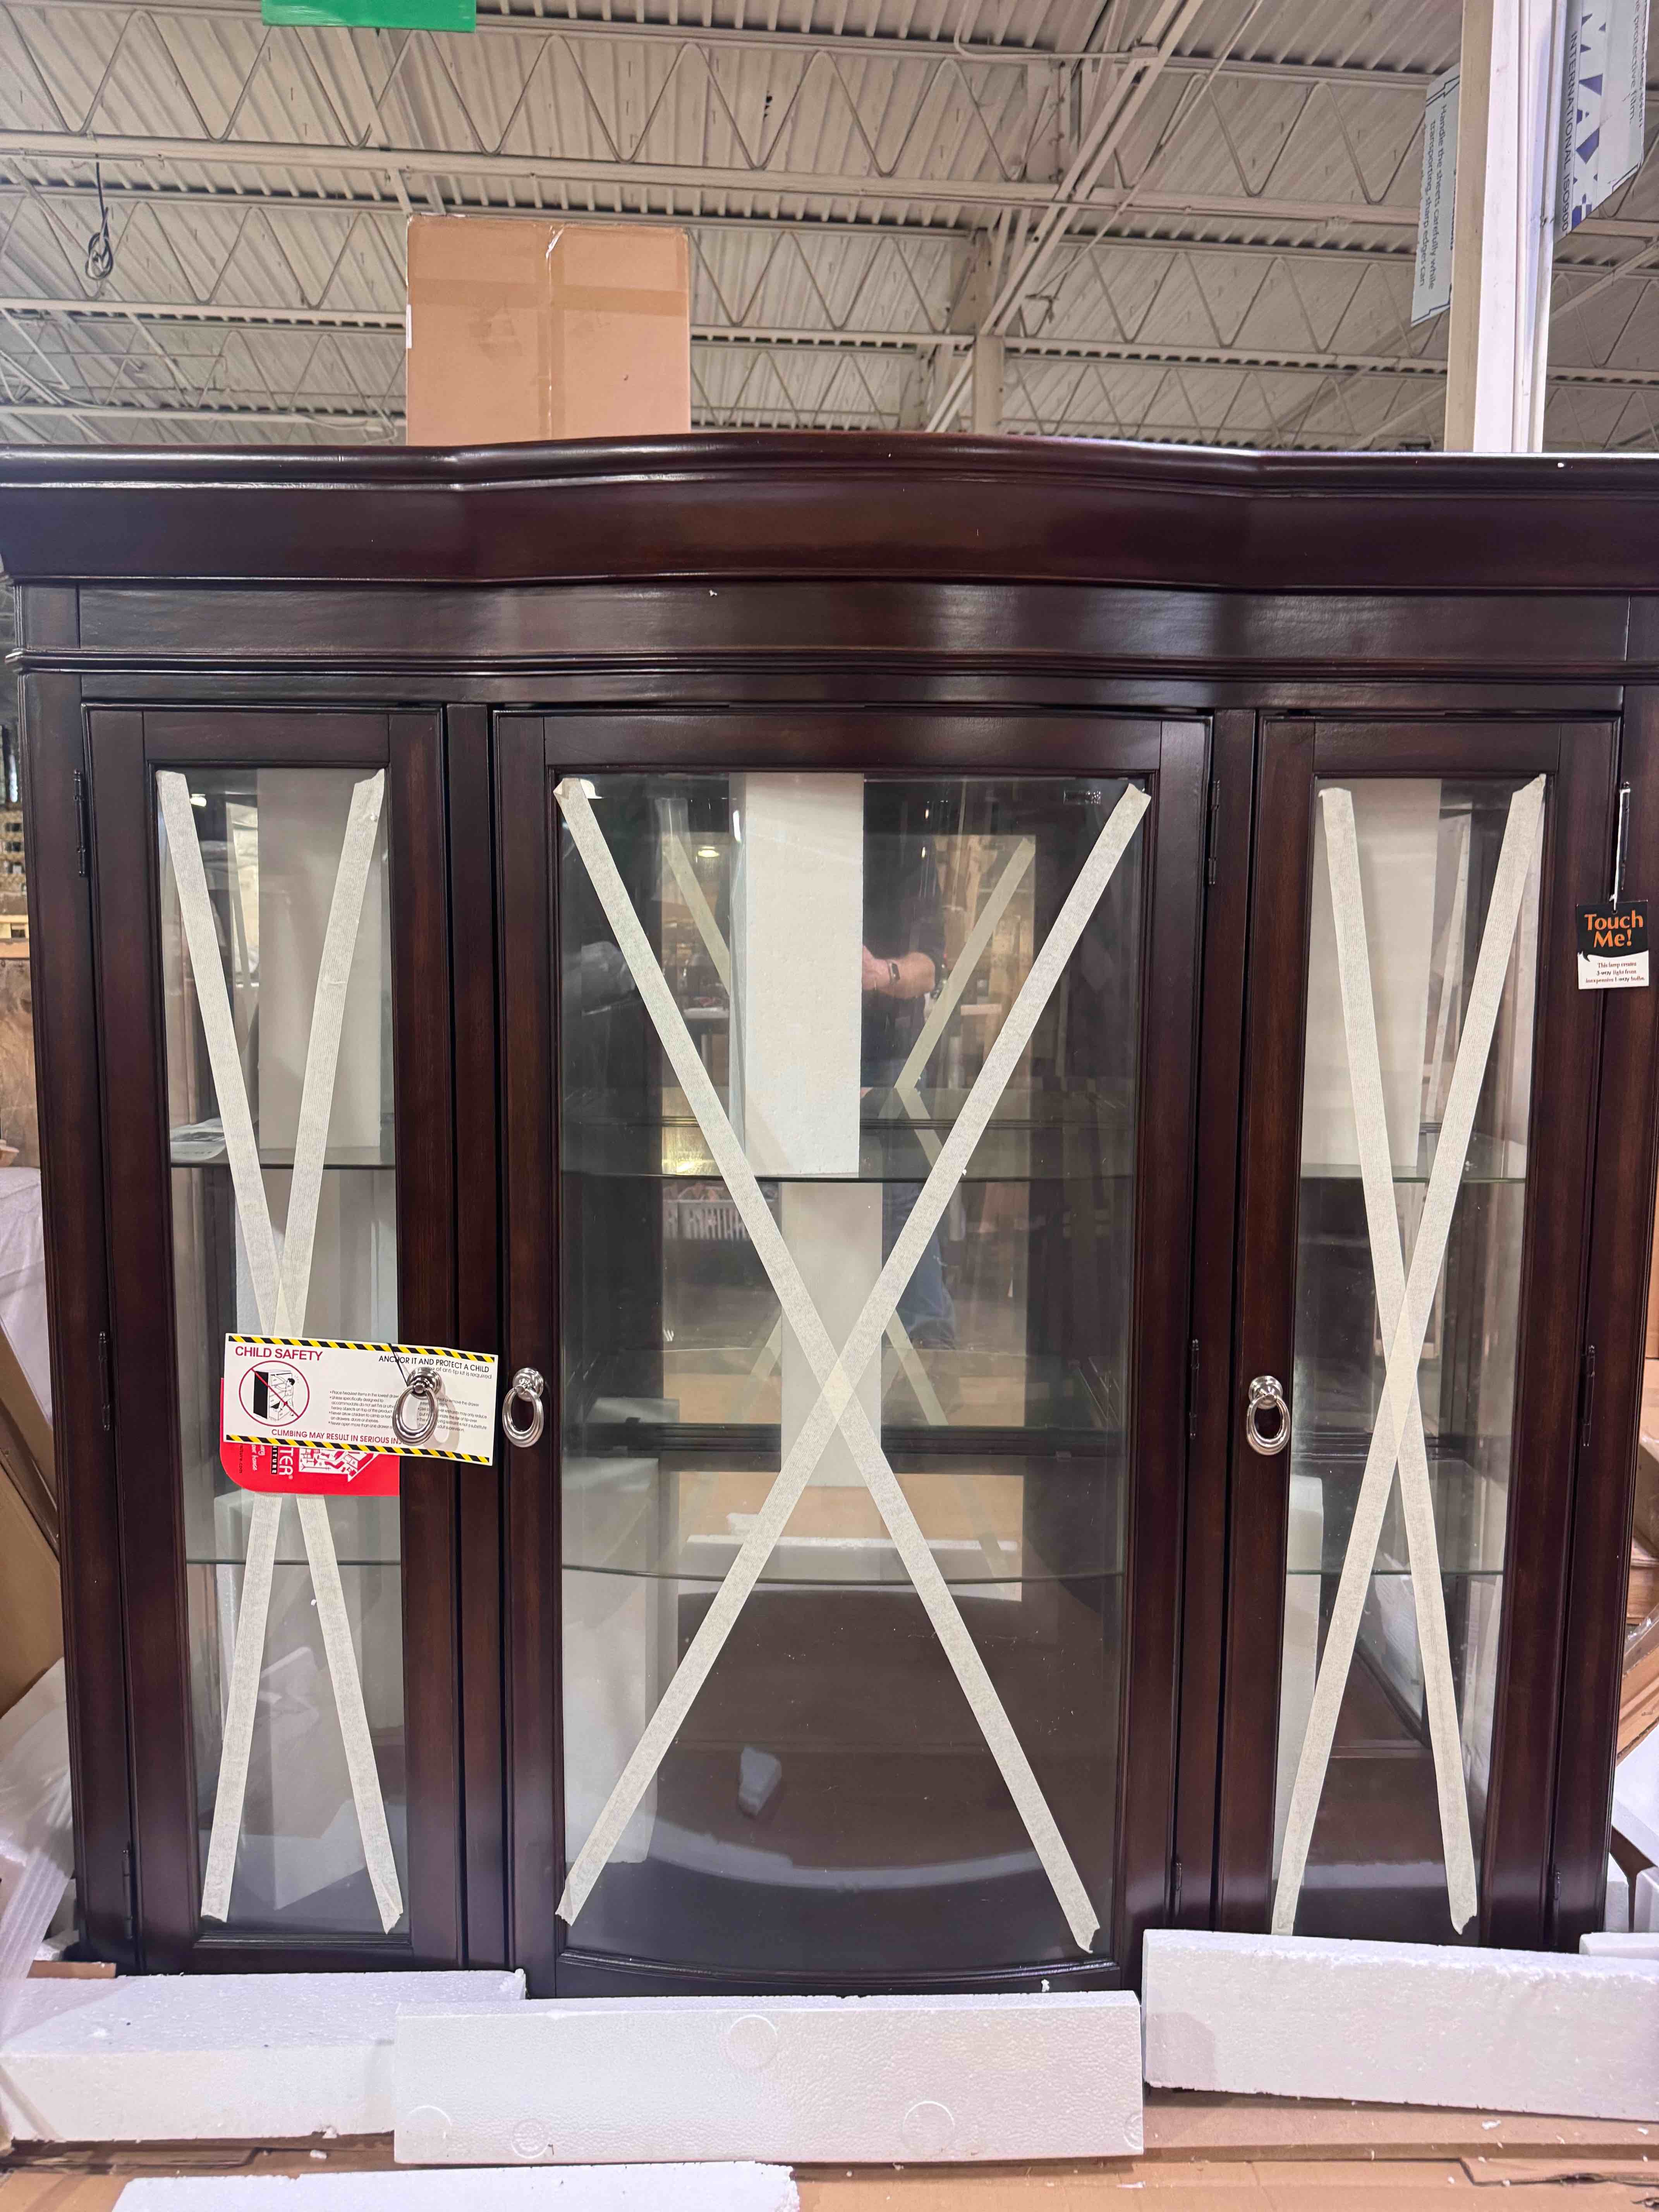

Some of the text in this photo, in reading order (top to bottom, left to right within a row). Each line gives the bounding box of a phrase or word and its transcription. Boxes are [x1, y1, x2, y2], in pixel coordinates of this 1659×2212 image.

[1631, 15, 1639, 88] protective
[1629, 89, 1637, 124] film.
[1439, 104, 1447, 146] Handle
[1562, 31, 1578, 235] INTERNATIONAL ISO900
[1424, 196, 1432, 228] sharp
[1420, 230, 1429, 264] edges
[1430, 208, 1439, 256] carefully
[1428, 259, 1436, 290] while
[1584, 910, 1644, 931] Touch
[1594, 929, 1632, 948] Me!
[235, 1346, 323, 1361] CHILD SAFETY
[379, 1355, 409, 1364] ANCHOR
[436, 1359, 463, 1369] PROTECT
[470, 1364, 489, 1373] CHILD
[272, 1429, 307, 1437] CLIMBING
[360, 1435, 389, 1444] SERIOUS
